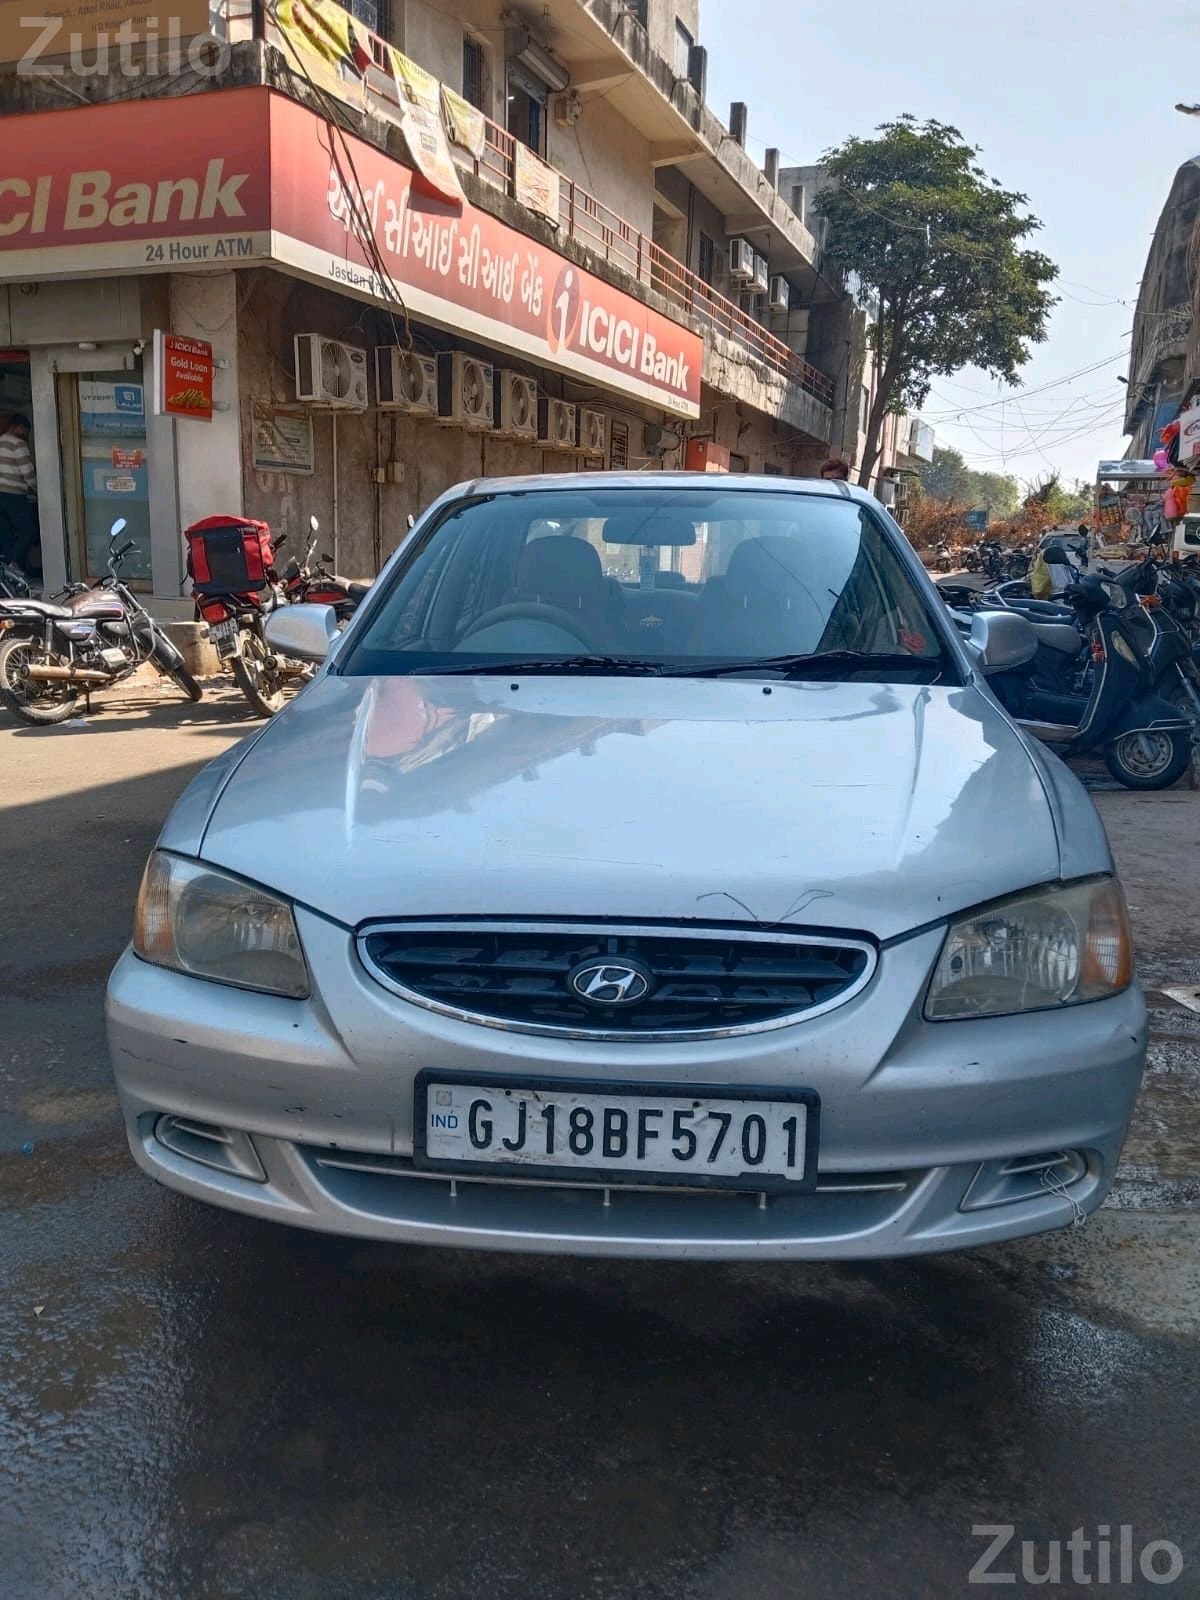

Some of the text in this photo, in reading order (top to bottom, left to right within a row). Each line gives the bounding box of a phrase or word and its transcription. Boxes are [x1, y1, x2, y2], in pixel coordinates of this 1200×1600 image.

[63, 158, 249, 231] Bank
[145, 238, 254, 262] 24 Hour ATM
[328, 258, 366, 289] Jasdan
[579, 300, 690, 392] ICICI Bank
[170, 356, 208, 374] Gold Loan
[431, 1113, 458, 1129] IND
[467, 1098, 799, 1169] GJ18BF5701
